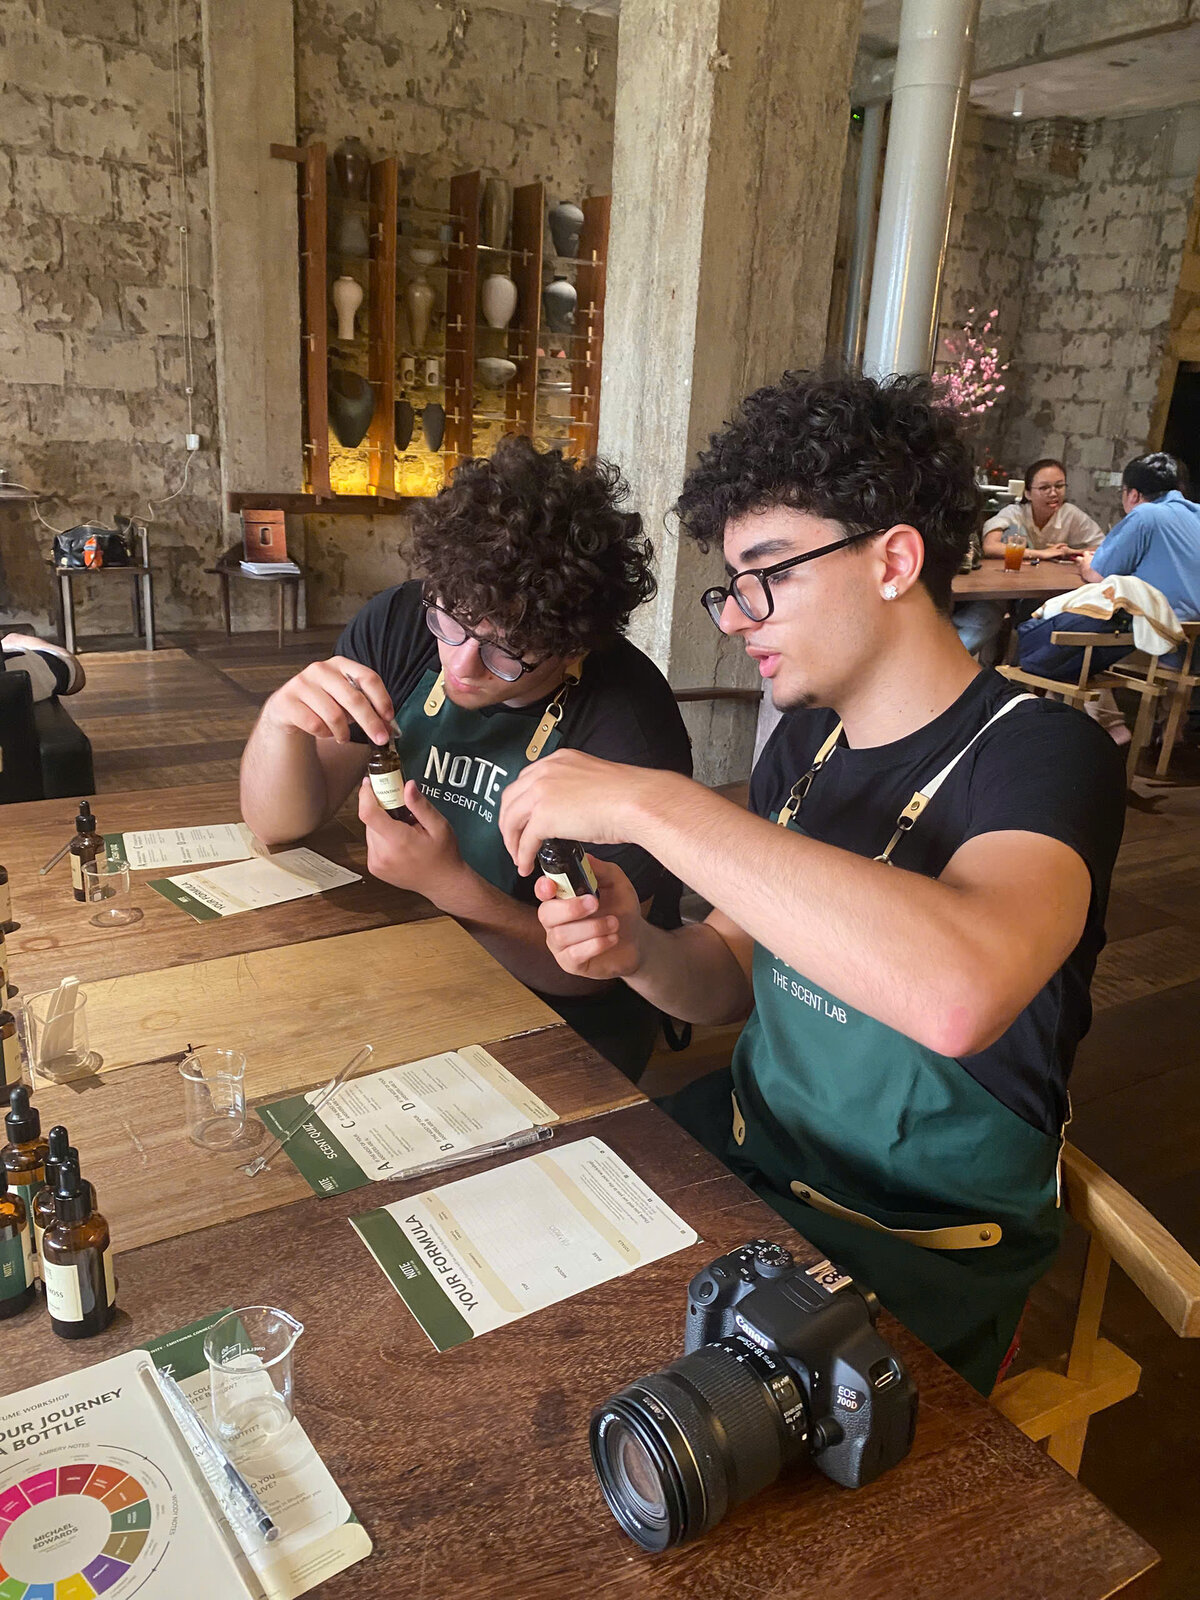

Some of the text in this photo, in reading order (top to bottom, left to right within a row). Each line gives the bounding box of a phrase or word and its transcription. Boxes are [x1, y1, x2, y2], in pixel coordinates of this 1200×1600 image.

[424, 745, 508, 807] NOTE
[420, 784, 492, 822] THE SCENT LAB
[772, 968, 847, 1024] THE SCENT LAB
[402, 1102, 416, 1111] D
[302, 1122, 322, 1139] QUIZ
[340, 1120, 356, 1129] C
[314, 1137, 338, 1161] SCENT
[440, 1142, 454, 1152] B
[377, 1161, 393, 1170] A
[318, 1177, 336, 1192] NOTE
[3, 1262, 12, 1278] NOTE
[398, 1261, 418, 1280] NOTE
[404, 1214, 479, 1312] YOUR FORMULA
[521, 1282, 530, 1291] TOP
[736, 1315, 768, 1350] Canon
[838, 1386, 856, 1400] EOS
[23, 1393, 70, 1414] WORKSHOP
[40, 1388, 122, 1429] JOURNEY
[643, 1396, 665, 1420] Canon
[836, 1396, 858, 1409] 700D
[13, 1416, 86, 1451] BOTTLE
[39, 1446, 67, 1456] AMBERY
[256, 1482, 278, 1495] LIVE?
[258, 1474, 276, 1485] YOU
[33, 1527, 78, 1550] EDWARDS
[34, 1523, 73, 1543] MICHAEL
